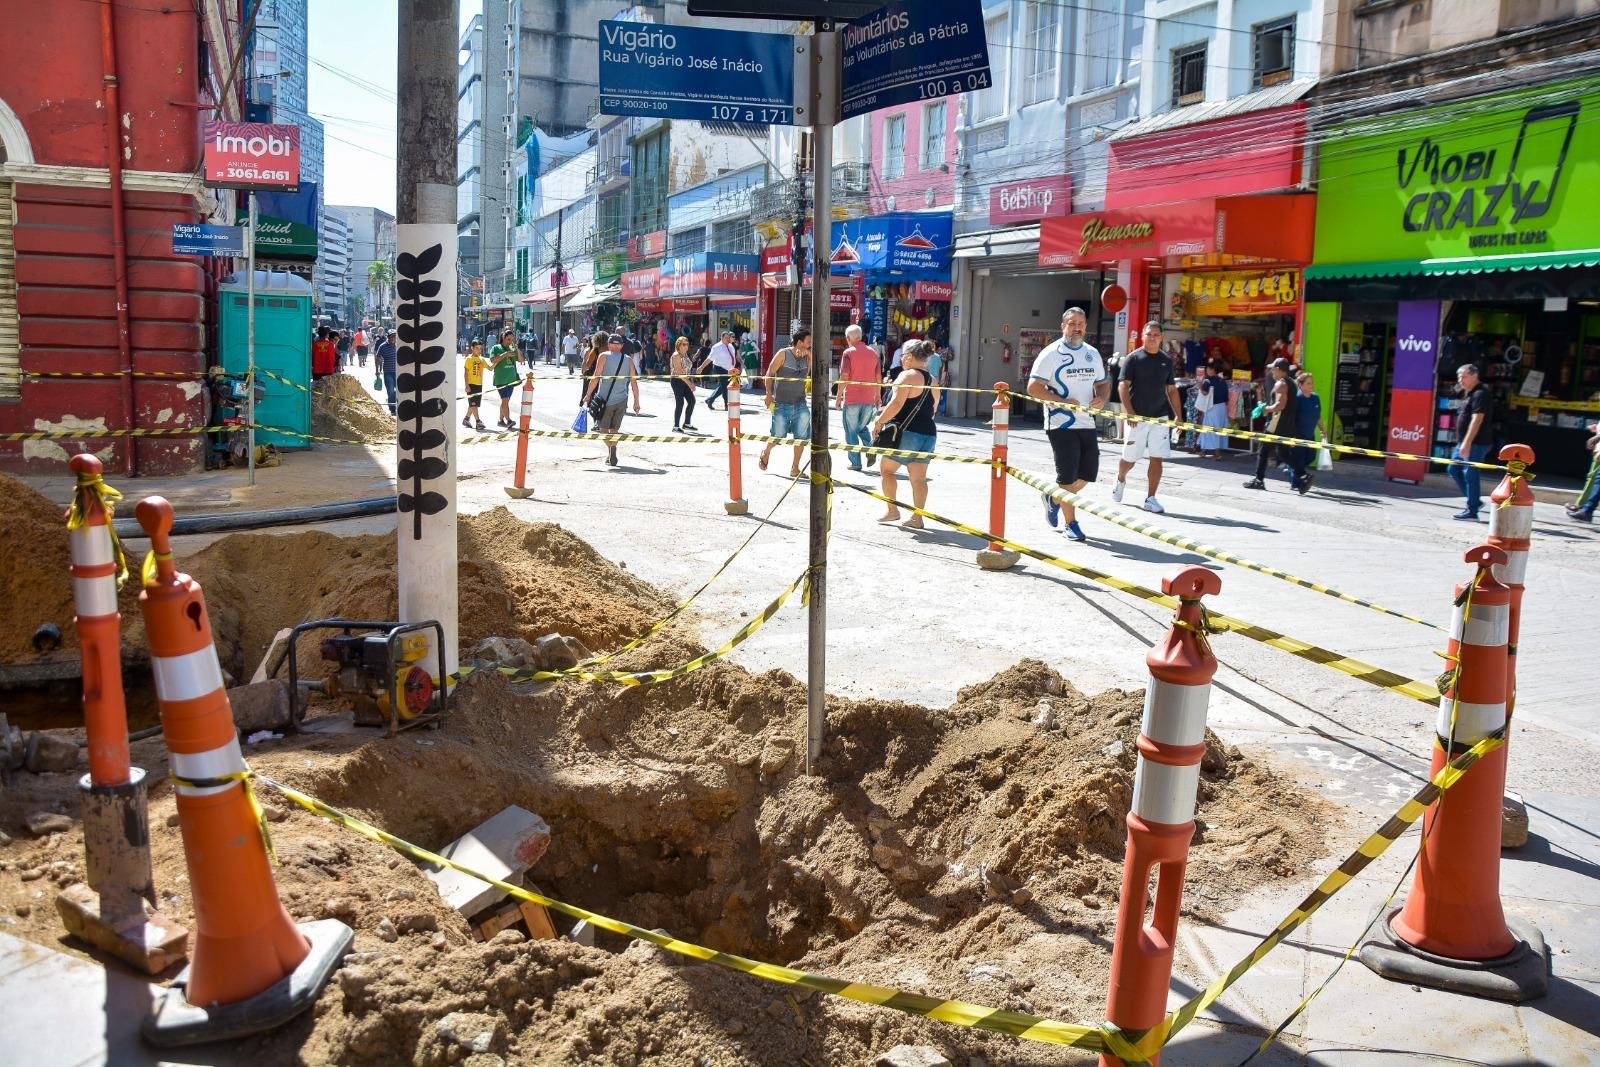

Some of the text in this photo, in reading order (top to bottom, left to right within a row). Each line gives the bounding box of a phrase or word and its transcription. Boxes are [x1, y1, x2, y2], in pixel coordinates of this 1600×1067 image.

[603, 25, 676, 51] Vigário
[843, 11, 910, 50] Voluntários
[843, 21, 969, 70] Rua Voluntários da Pátria
[603, 50, 763, 73] Rua Vigário José Inácio
[919, 80, 947, 98] 100
[953, 80, 962, 93] a
[967, 72, 988, 89] 04
[604, 99, 668, 110] CEP 90020-100
[711, 105, 788, 123] 107 a 171
[216, 131, 290, 157] imobi
[227, 161, 259, 169] ANUNCIE
[227, 168, 290, 181] 3061.6161
[1397, 137, 1497, 189] MOBI
[1000, 184, 1053, 214] BelShop
[1403, 179, 1541, 232] CRAZY
[174, 224, 201, 233] Vigário
[1078, 217, 1154, 257] Glamour
[921, 284, 952, 297] BelShop
[1398, 334, 1432, 352] vivo
[1391, 425, 1422, 441] Claro
